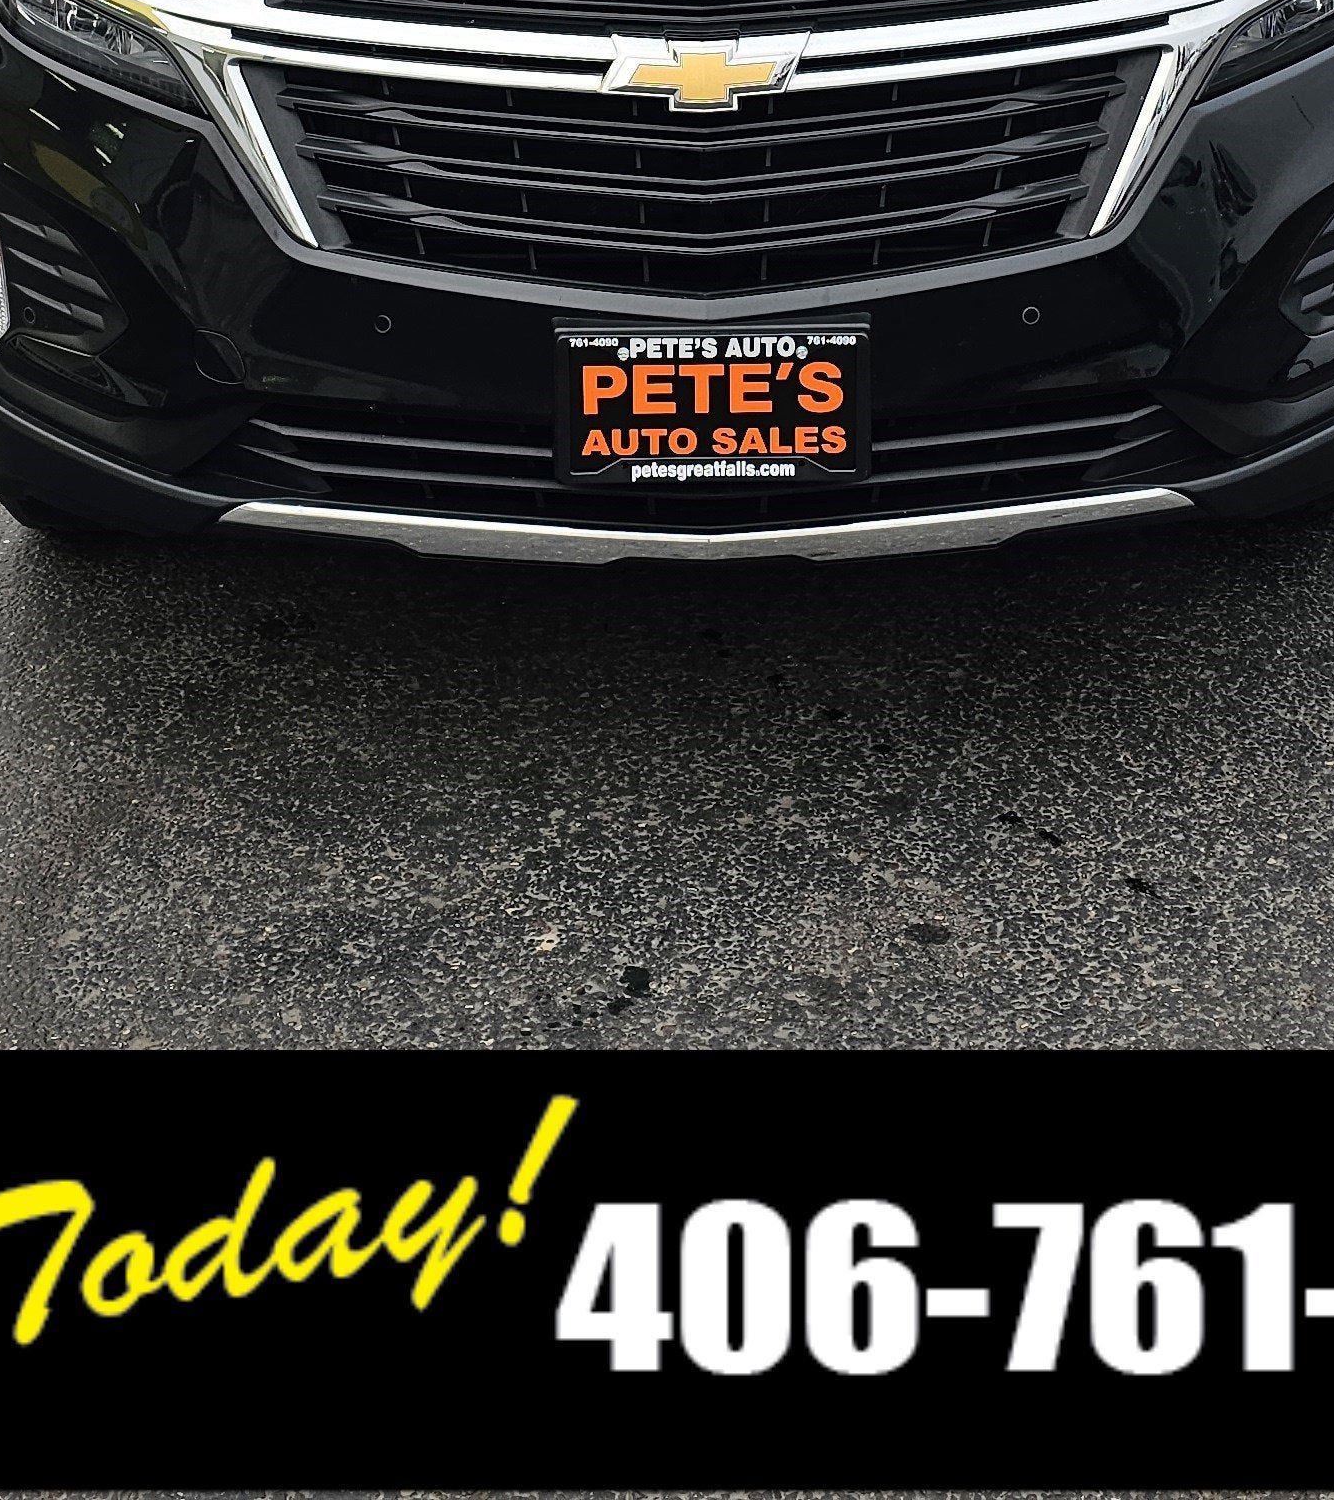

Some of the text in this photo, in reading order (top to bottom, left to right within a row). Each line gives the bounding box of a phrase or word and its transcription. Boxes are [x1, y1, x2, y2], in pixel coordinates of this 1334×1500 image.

[569, 337, 619, 348] 761-4090
[629, 336, 796, 359] PETE'S AUTO
[582, 361, 844, 415] PETE'S
[581, 425, 847, 456] AUTO SALES
[631, 460, 796, 482] petesgreatfalls.com
